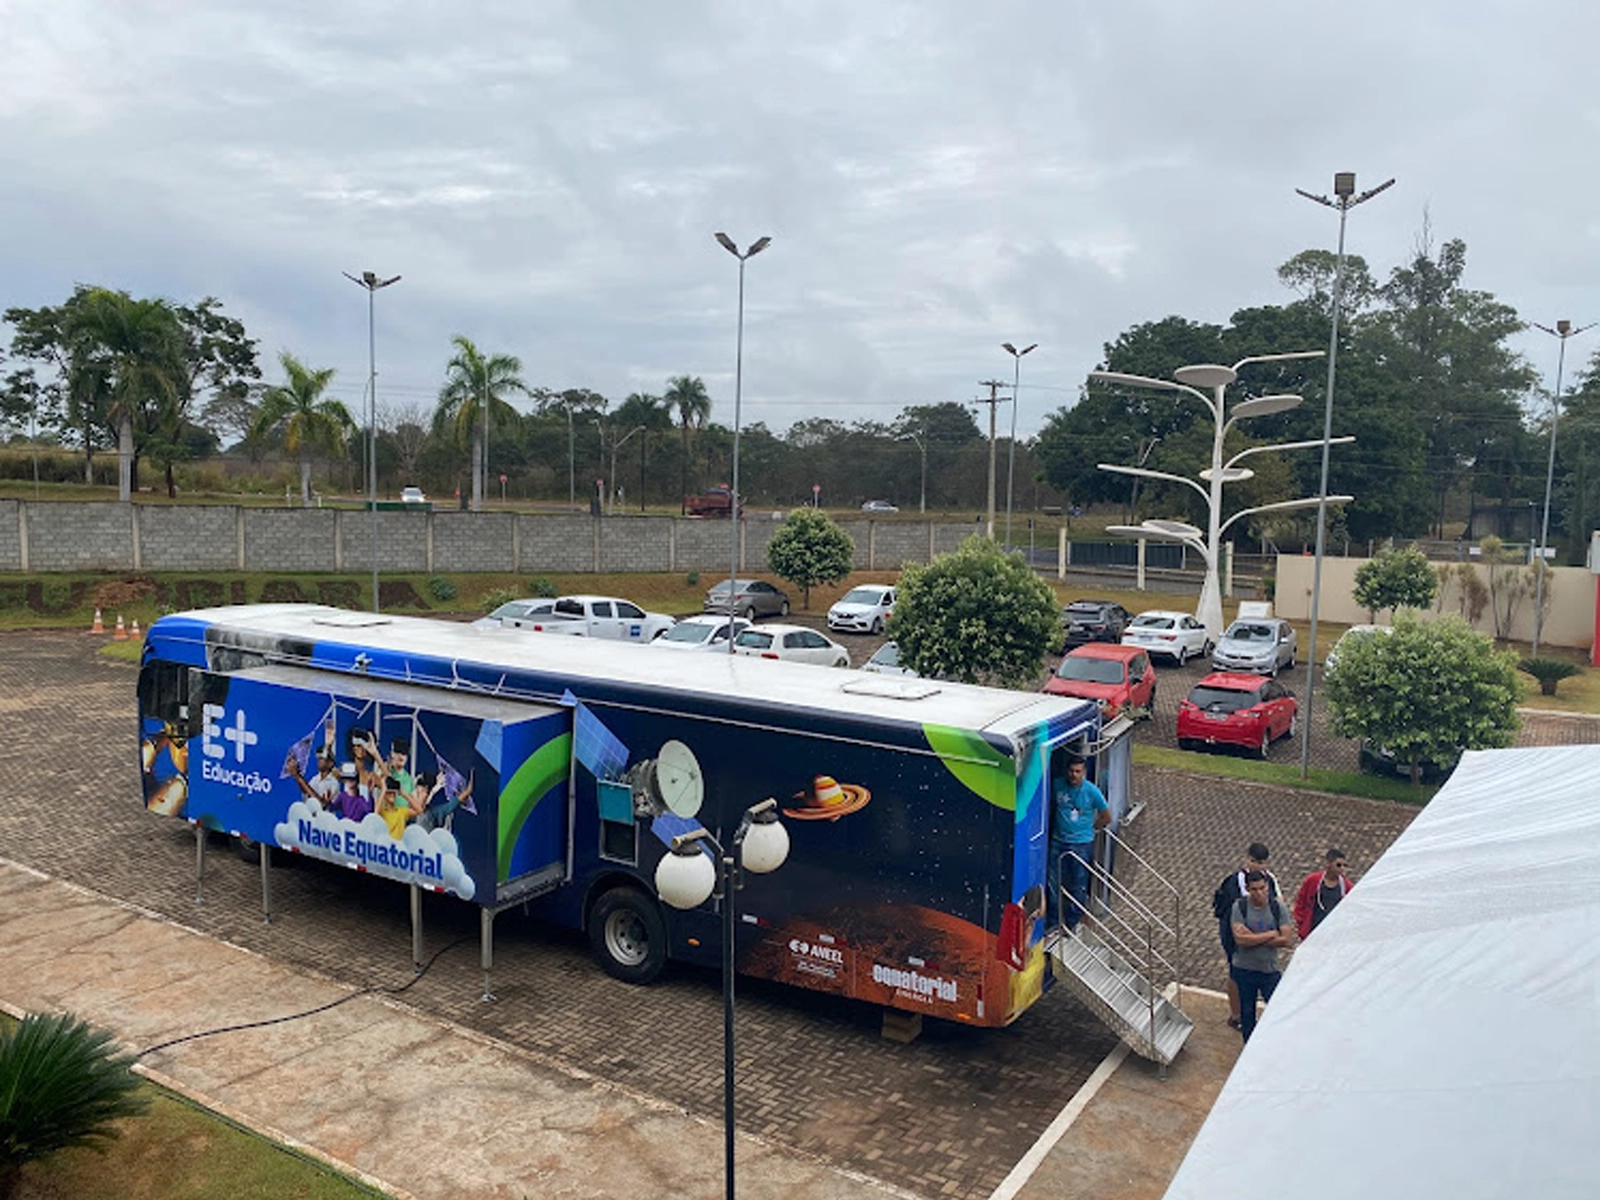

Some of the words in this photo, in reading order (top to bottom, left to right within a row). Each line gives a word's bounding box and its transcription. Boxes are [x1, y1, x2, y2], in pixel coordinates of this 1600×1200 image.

[203, 704, 258, 763] E+
[203, 760, 271, 794] Educação
[298, 819, 342, 852] Nave
[344, 831, 443, 880] Equatorial
[873, 964, 957, 1002] equatorial
